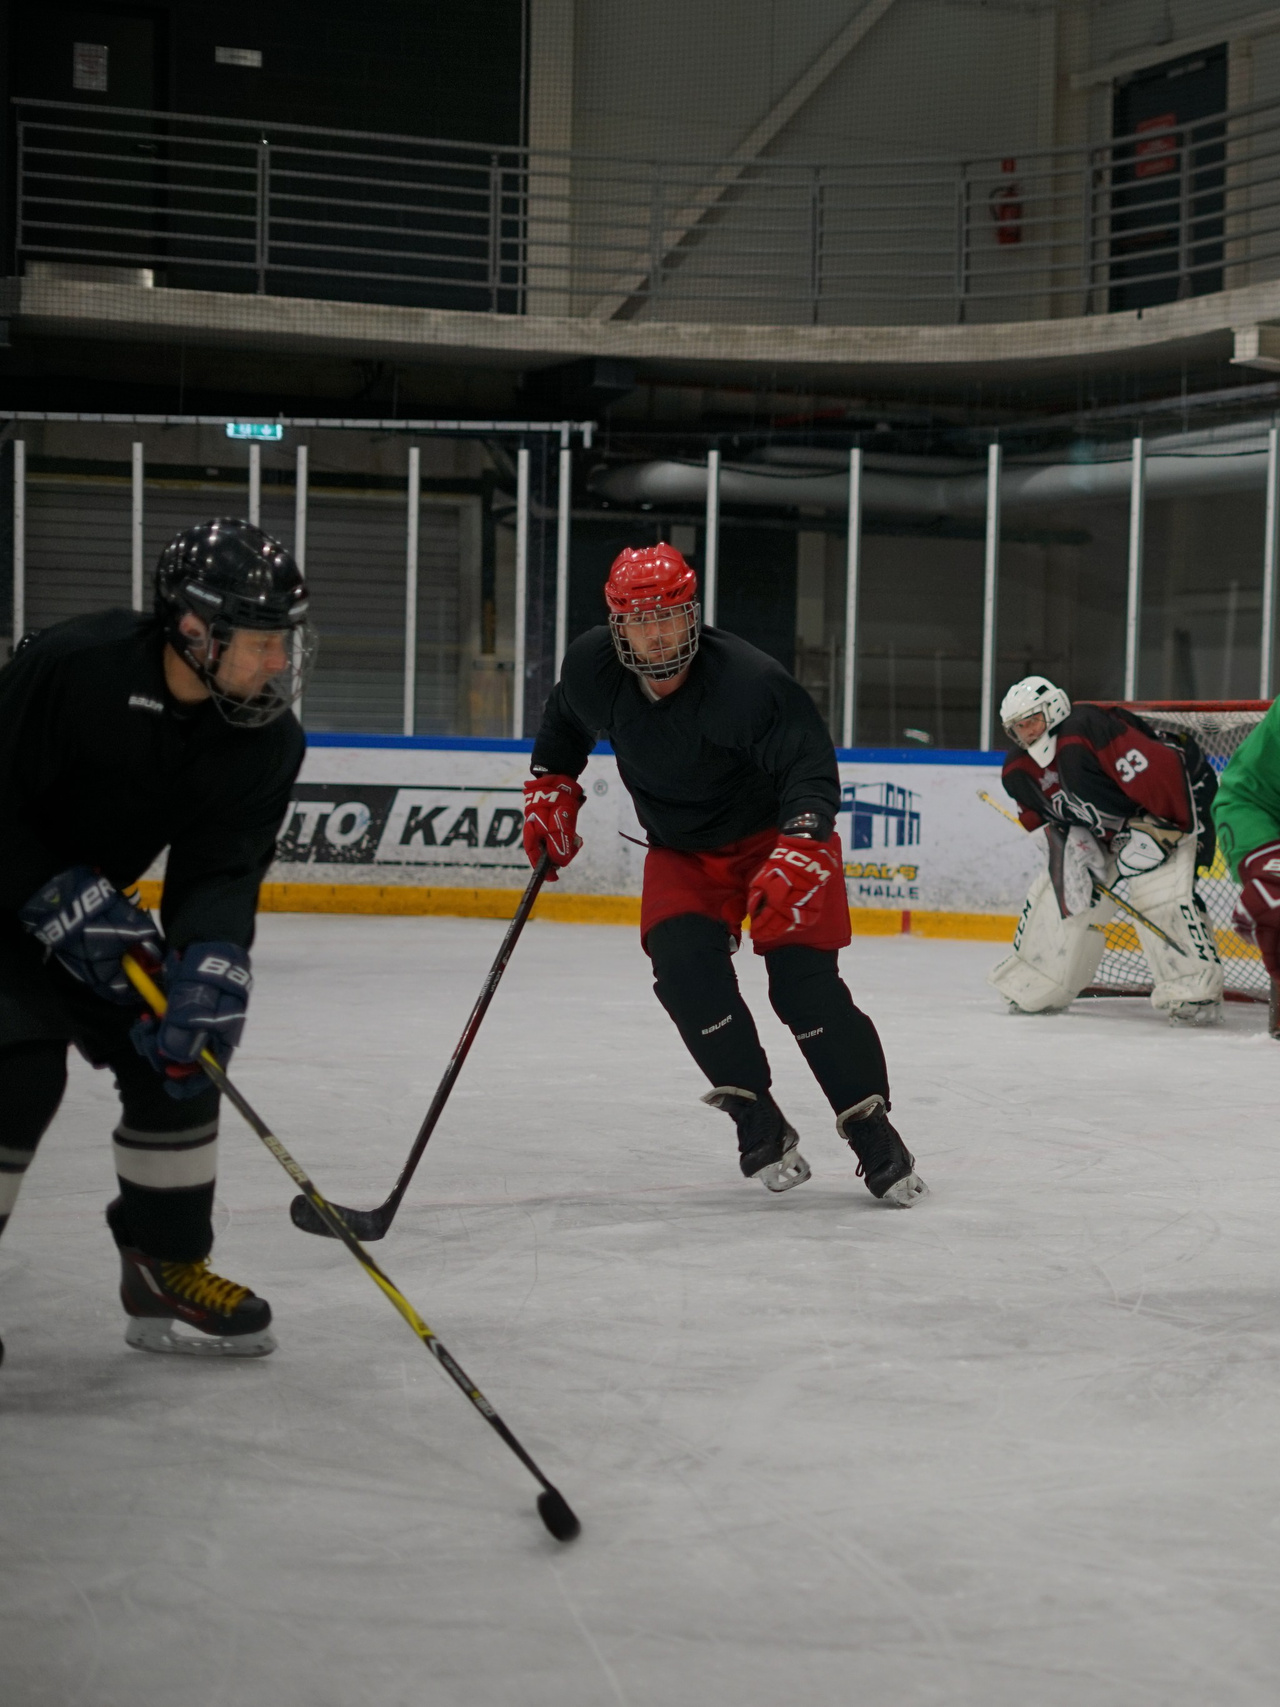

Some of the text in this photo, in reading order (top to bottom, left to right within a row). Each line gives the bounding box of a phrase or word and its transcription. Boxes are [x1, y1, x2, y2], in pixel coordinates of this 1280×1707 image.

[1115, 748, 1149, 783] 33
[524, 790, 560, 806] CM
[399, 805, 527, 848] KAD
[769, 847, 832, 882] CCM
[858, 884, 919, 900] HALLE
[1013, 898, 1032, 951] CCM
[1180, 904, 1209, 962] CCM
[197, 956, 252, 988] BA
[701, 1013, 733, 1036] BAUER
[263, 1135, 309, 1184] BAUER
